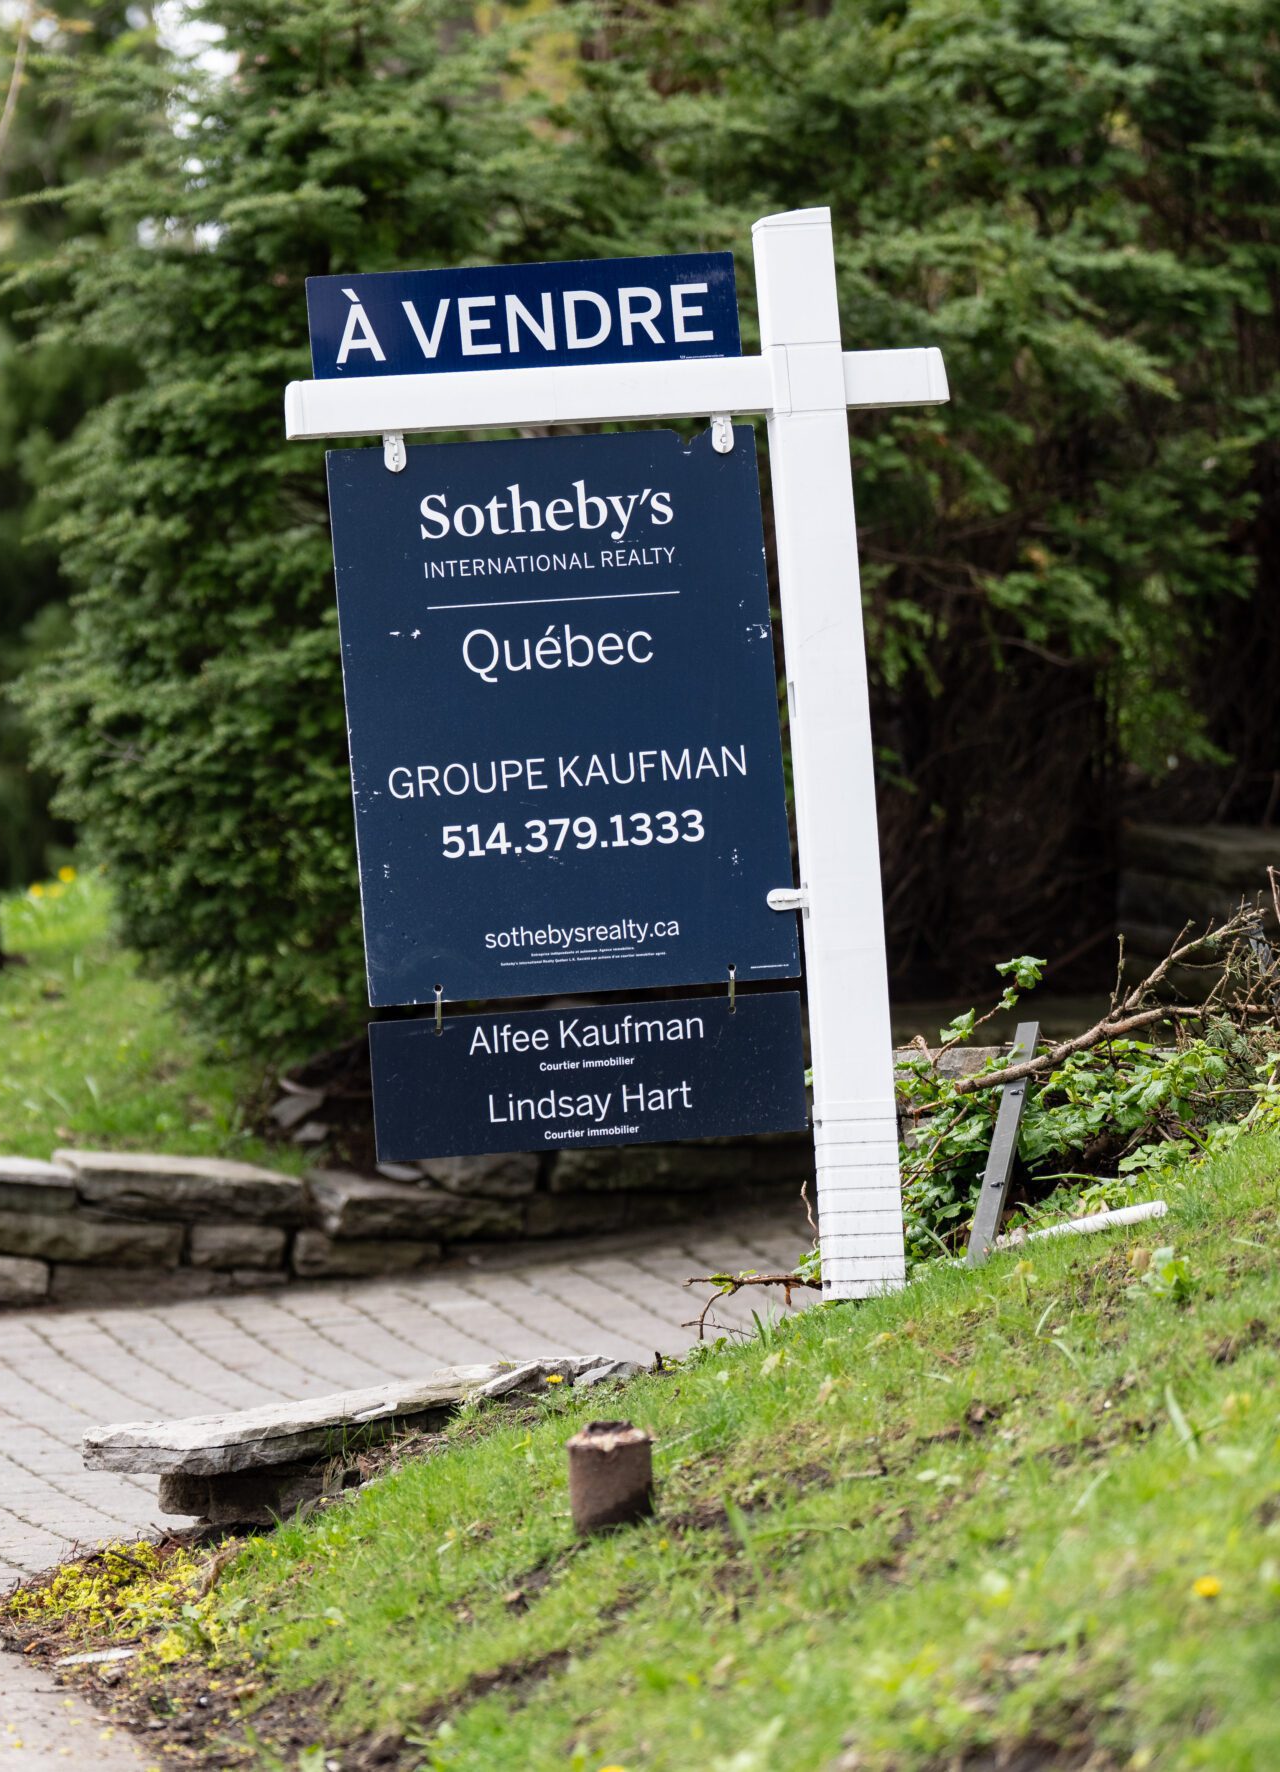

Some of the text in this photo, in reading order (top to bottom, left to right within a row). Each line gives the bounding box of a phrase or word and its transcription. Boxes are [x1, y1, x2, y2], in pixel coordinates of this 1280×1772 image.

[336, 282, 714, 364] À VENDRE
[420, 480, 675, 541] Sotheby's
[424, 547, 676, 579] INTERNATIONAL REALTY
[462, 623, 654, 683] Québec
[389, 745, 747, 800] GROUPE KAUFMAN
[442, 809, 705, 859] 514.379.1333
[485, 918, 681, 949] sothebysrealty.ca
[469, 1015, 705, 1056] Alfee Kaufman
[540, 1056, 635, 1072] Courtier immobilier
[489, 1080, 693, 1123] Lindsay Hart
[544, 1124, 640, 1140] Courtier immobilier
